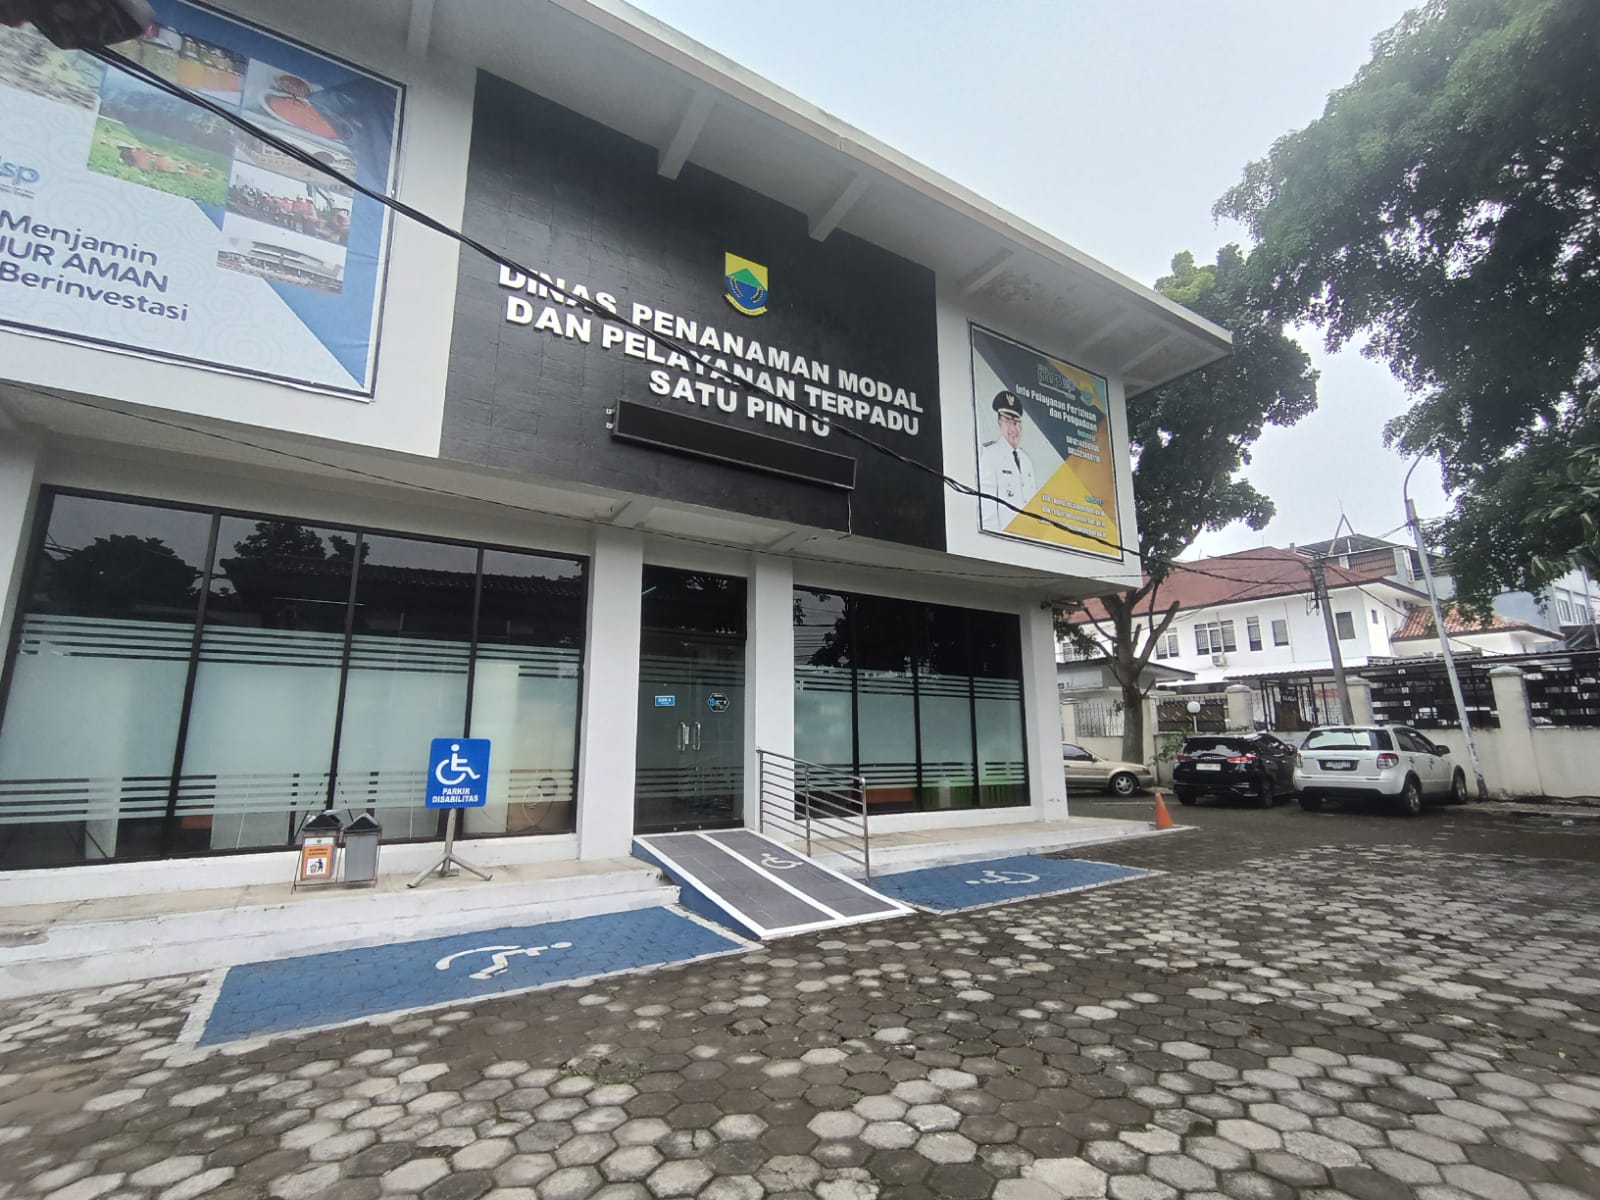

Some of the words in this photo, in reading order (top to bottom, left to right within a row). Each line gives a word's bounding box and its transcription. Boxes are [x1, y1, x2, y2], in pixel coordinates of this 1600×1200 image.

[0, 161, 40, 185] sp
[0, 210, 158, 266] Menjamin
[0, 261, 188, 321] Berinvestasi
[62, 253, 168, 292] AMAN
[498, 263, 617, 315] DINAS
[632, 302, 830, 385] PENANAMAN
[838, 369, 924, 414] MODAL
[506, 295, 592, 343] DAN
[602, 323, 795, 402] PELAYANAN
[804, 384, 919, 436] TERPADU
[649, 369, 738, 413] SATU
[747, 395, 831, 437] PINTU
[1049, 407, 1062, 420] dan
[431, 795, 479, 804] DISABILITAS
[442, 787, 471, 796] PARKIR
